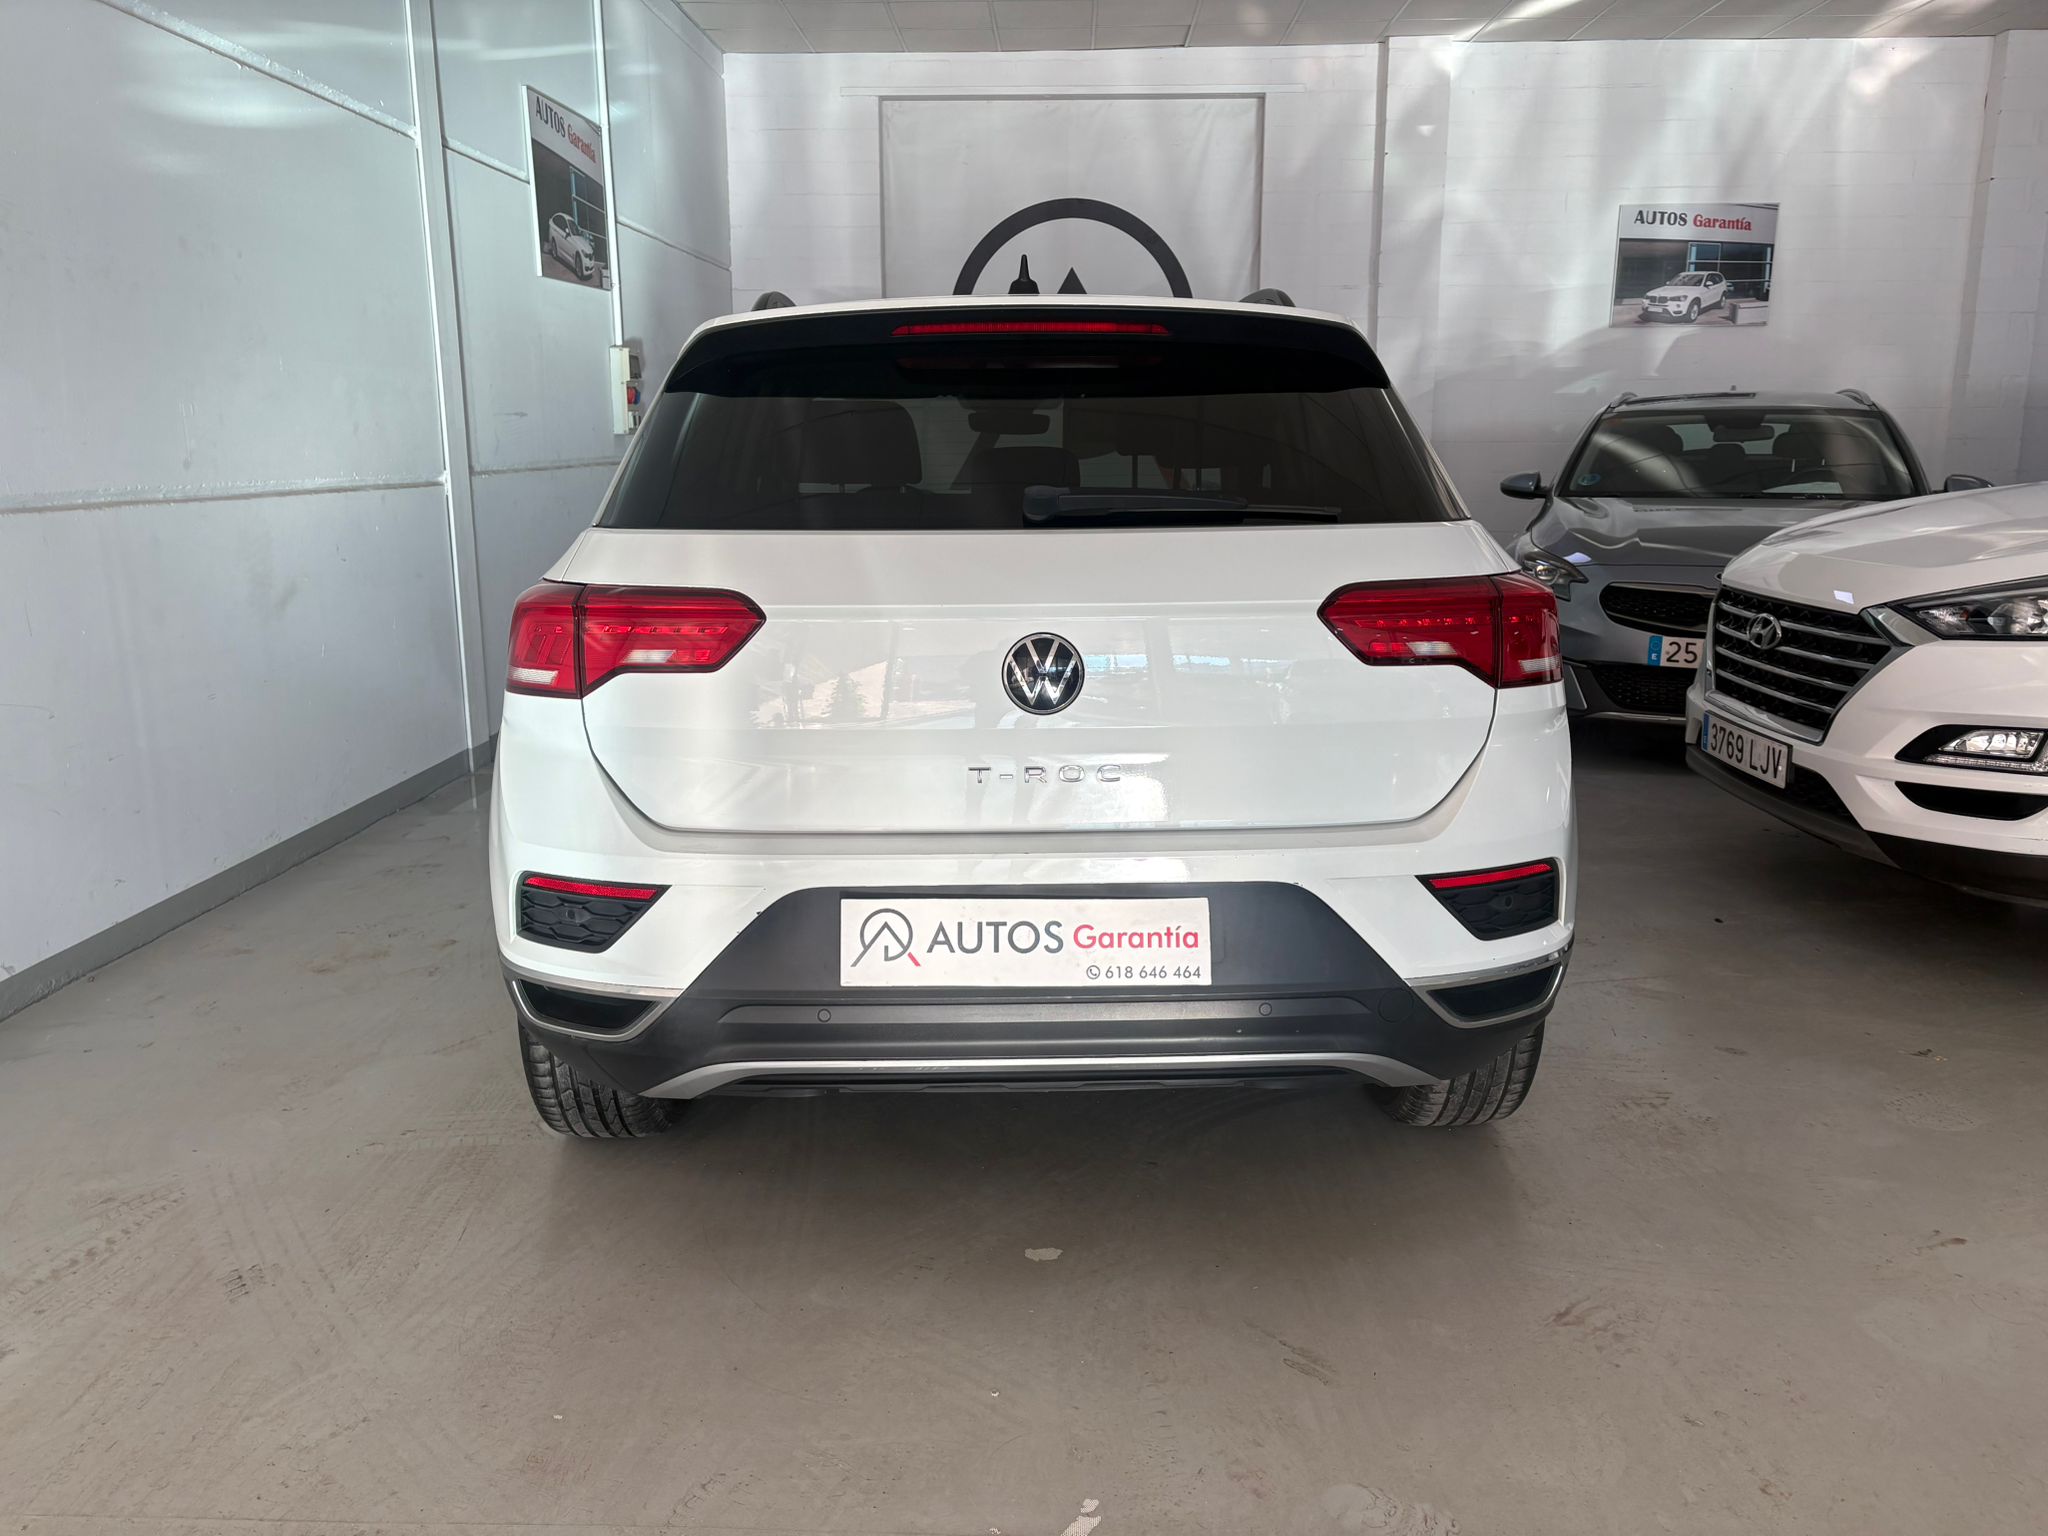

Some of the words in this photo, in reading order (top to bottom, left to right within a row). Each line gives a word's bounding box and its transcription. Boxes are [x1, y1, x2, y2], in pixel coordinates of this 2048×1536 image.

[535, 96, 566, 138] AUTOS
[1634, 210, 1688, 226] AUTOS
[1693, 214, 1752, 231] Garantía
[1710, 723, 1744, 763] 3769
[1749, 739, 1782, 779] LJV
[968, 765, 1121, 783] T-ROC
[926, 920, 1063, 954] AUTOS
[1073, 924, 1199, 949] Garantía
[1105, 966, 1133, 979] 618
[1139, 966, 1167, 979] 646
[1173, 966, 1201, 979] 464
